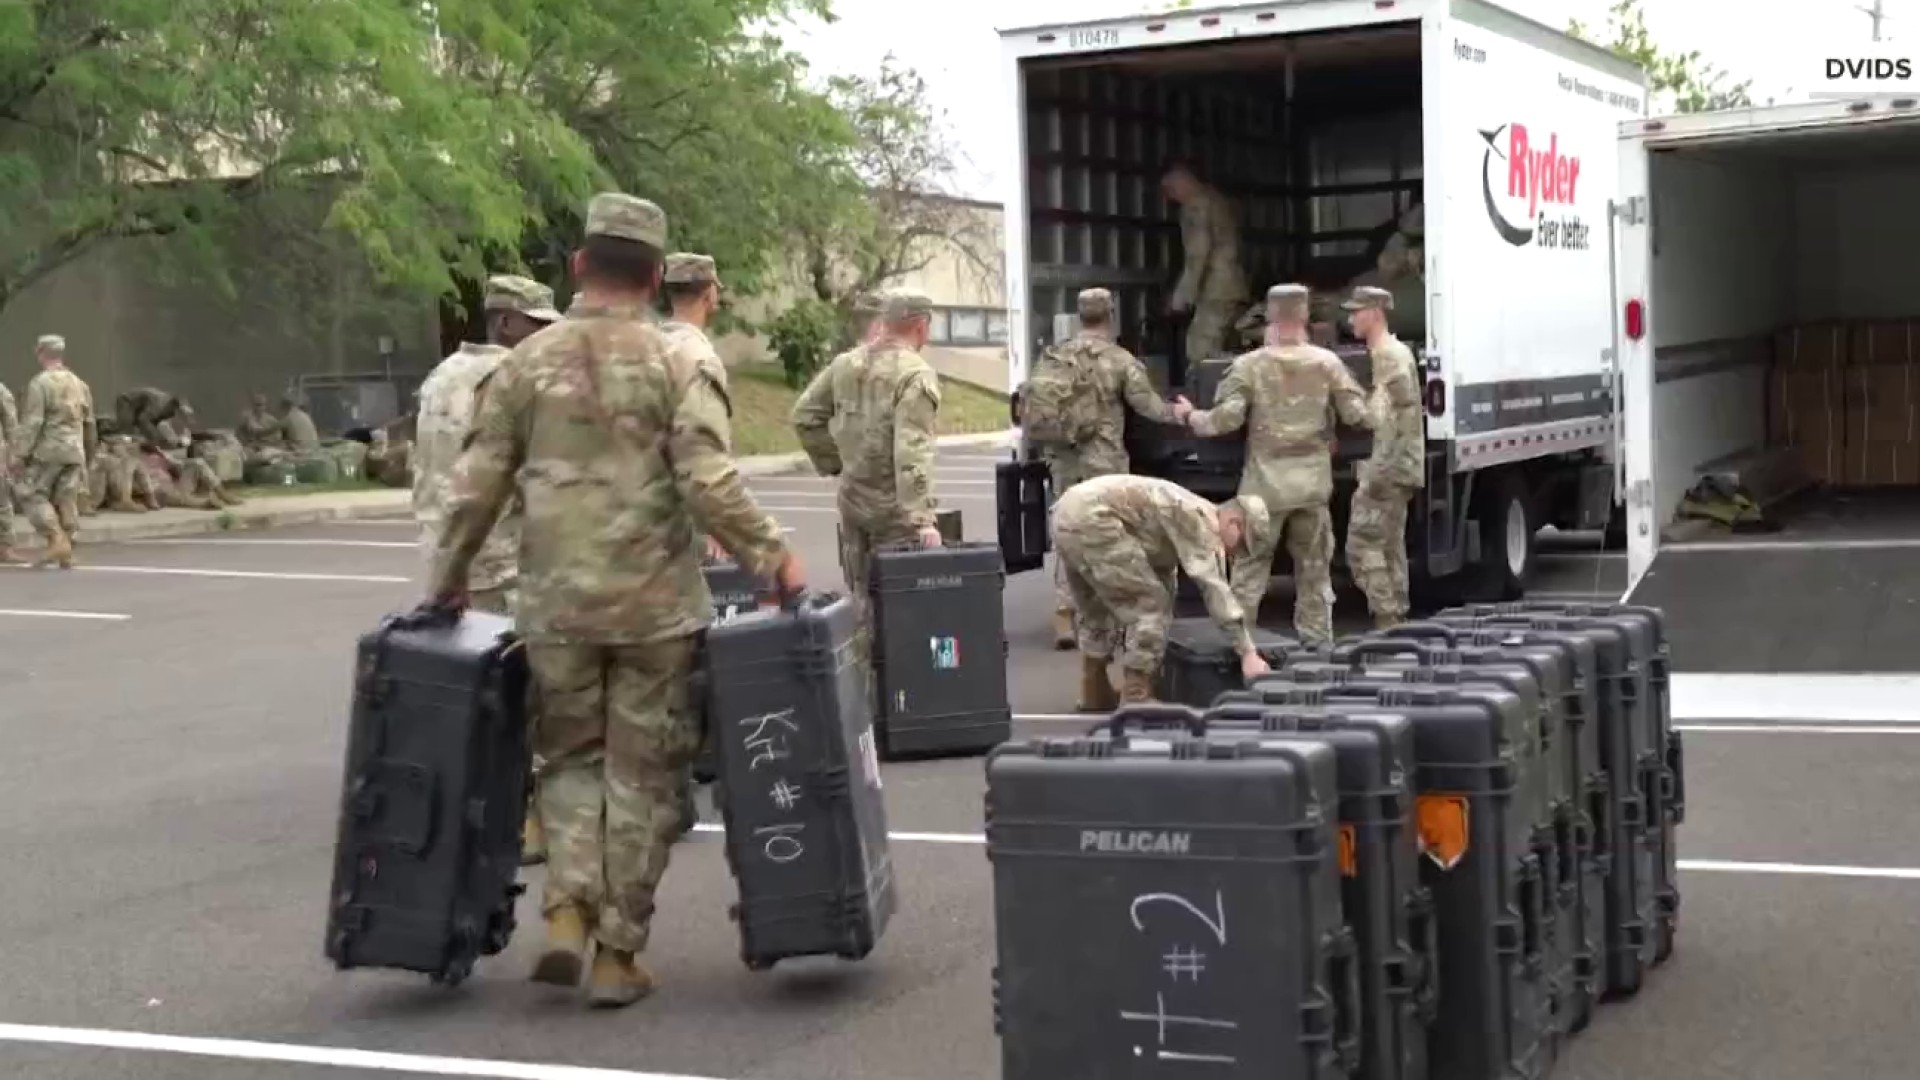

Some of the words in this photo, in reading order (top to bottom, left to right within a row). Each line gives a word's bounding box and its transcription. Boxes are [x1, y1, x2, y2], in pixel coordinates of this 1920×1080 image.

[1508, 122, 1580, 218] Ryder
[1538, 211, 1559, 248] Ever
[1080, 830, 1190, 854] PELICAN
